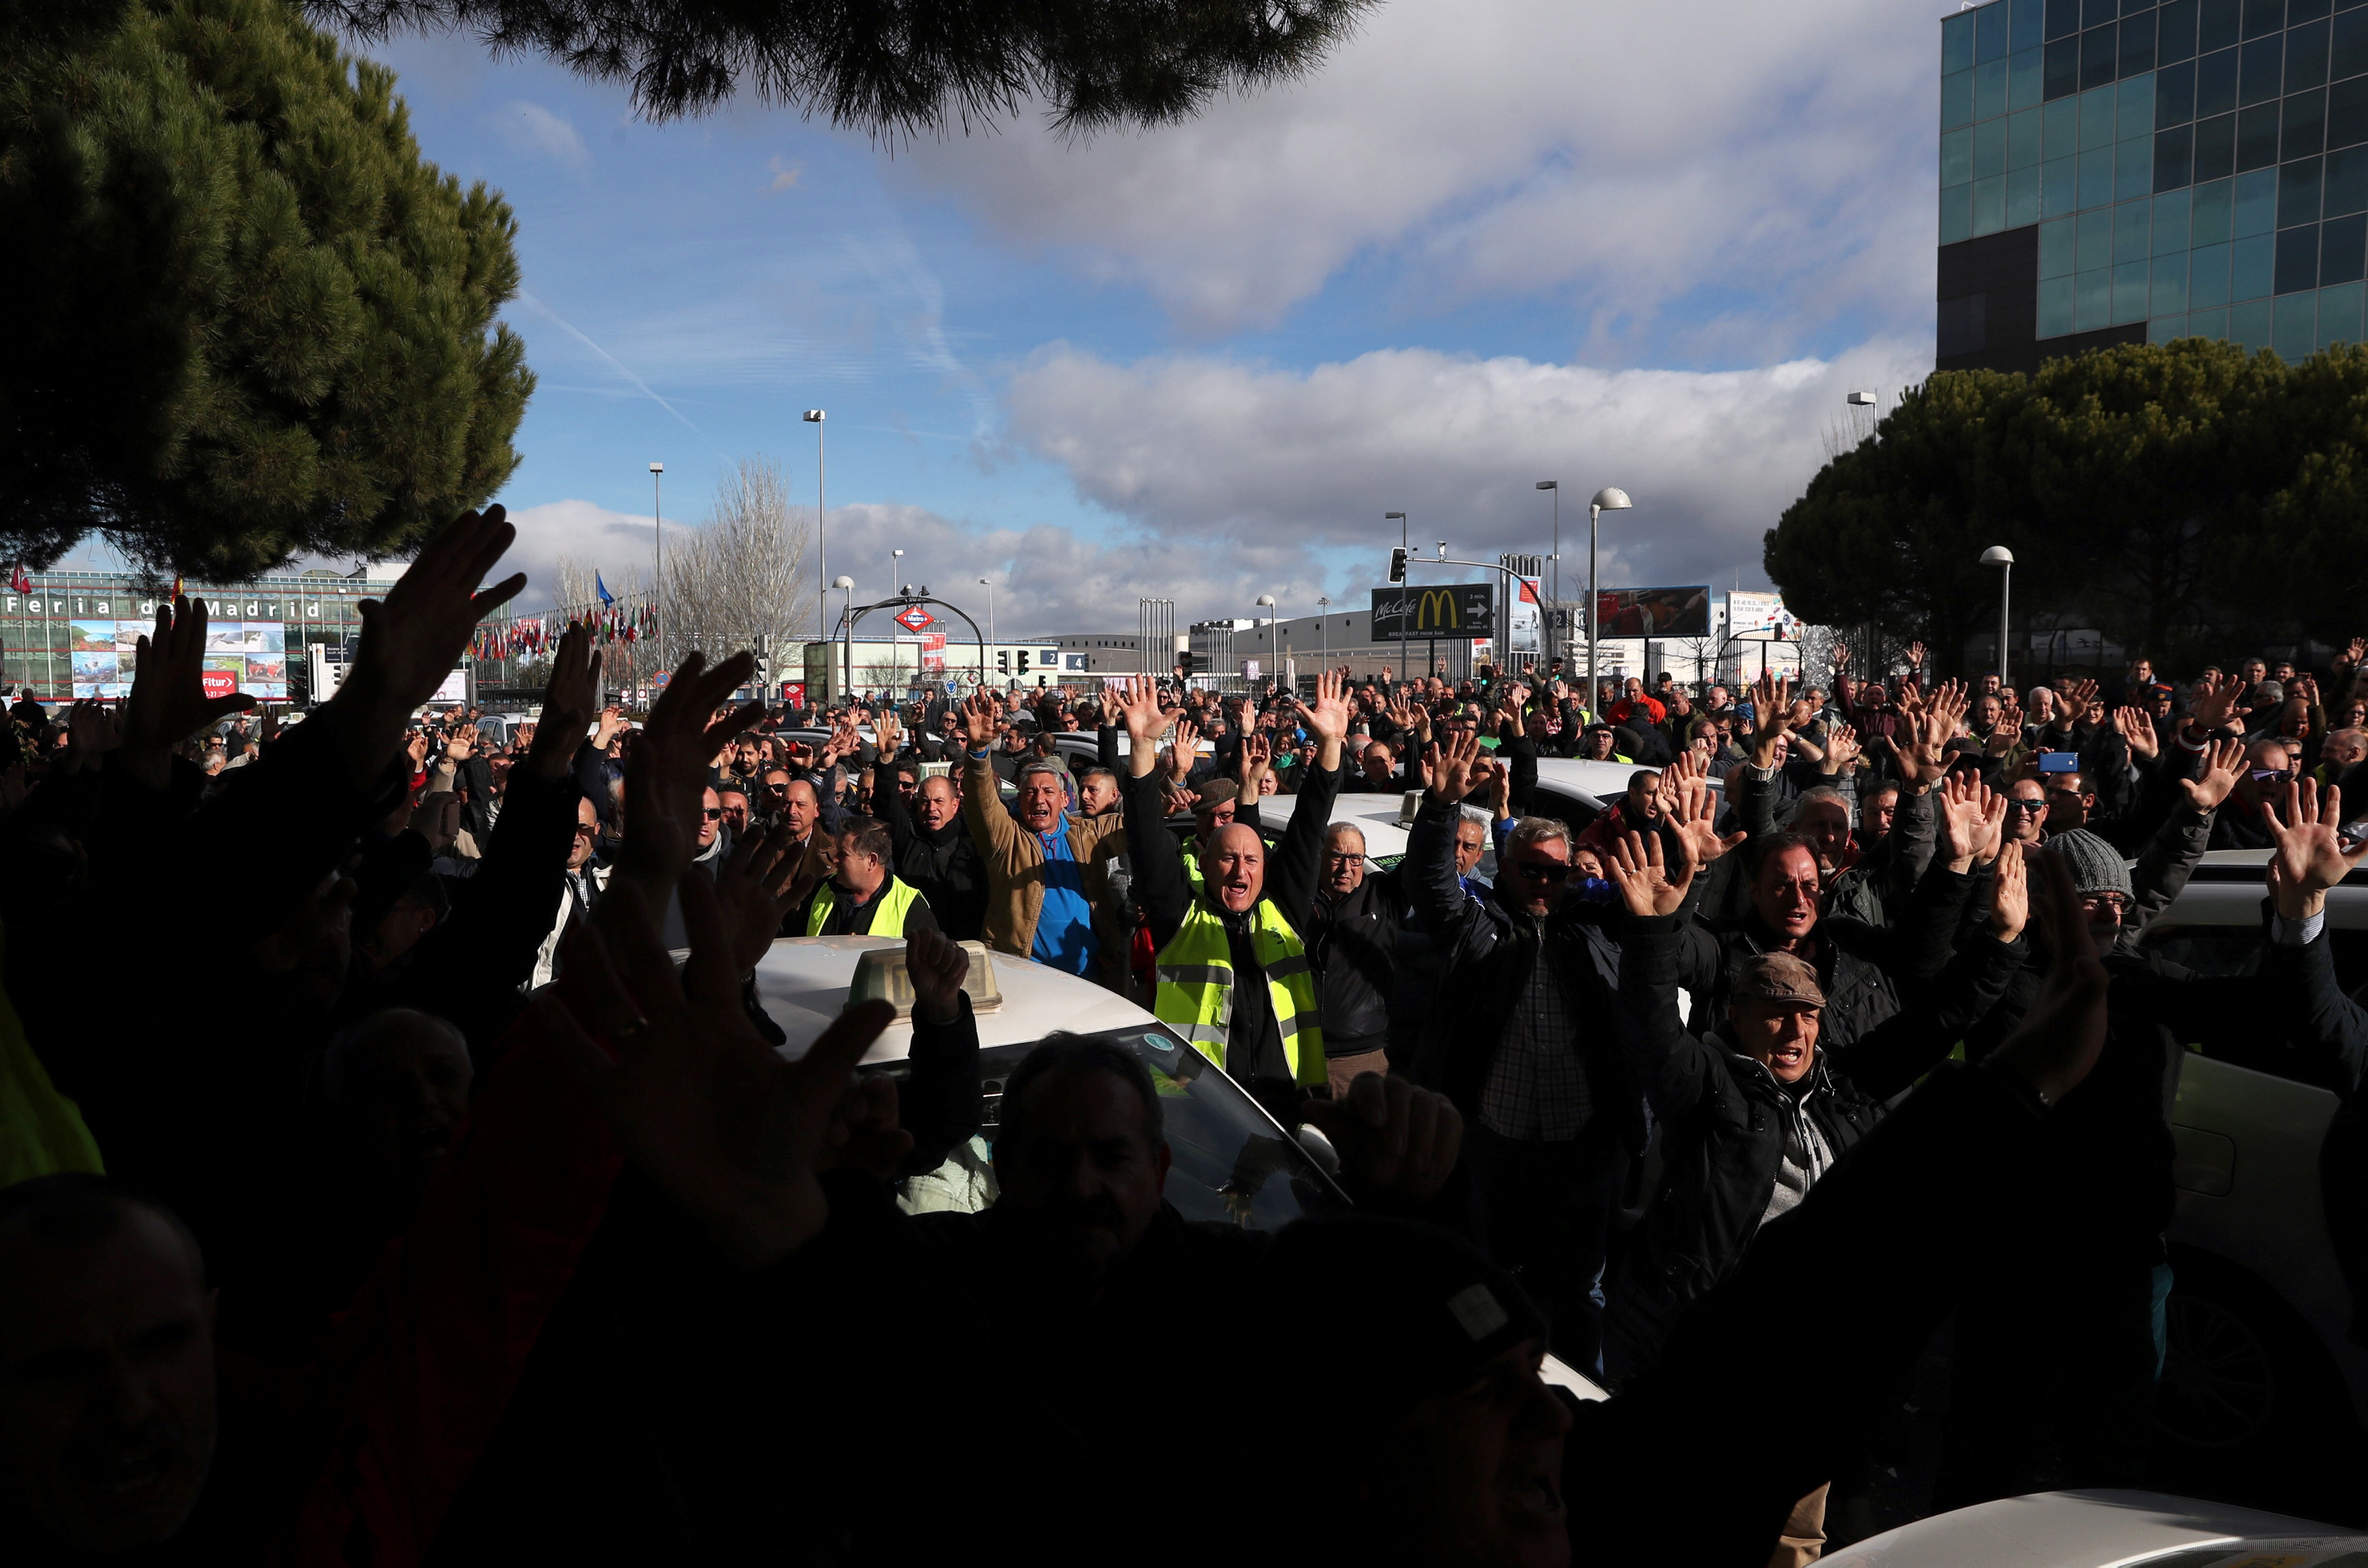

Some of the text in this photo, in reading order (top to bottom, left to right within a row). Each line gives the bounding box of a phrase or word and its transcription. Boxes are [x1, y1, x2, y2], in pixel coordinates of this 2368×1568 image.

[6, 597, 110, 614] Feria
[205, 600, 319, 617] Madrid
[1049, 653, 1055, 663] 2
[1075, 658, 1083, 668] 4
[202, 677, 227, 687] Fitur
